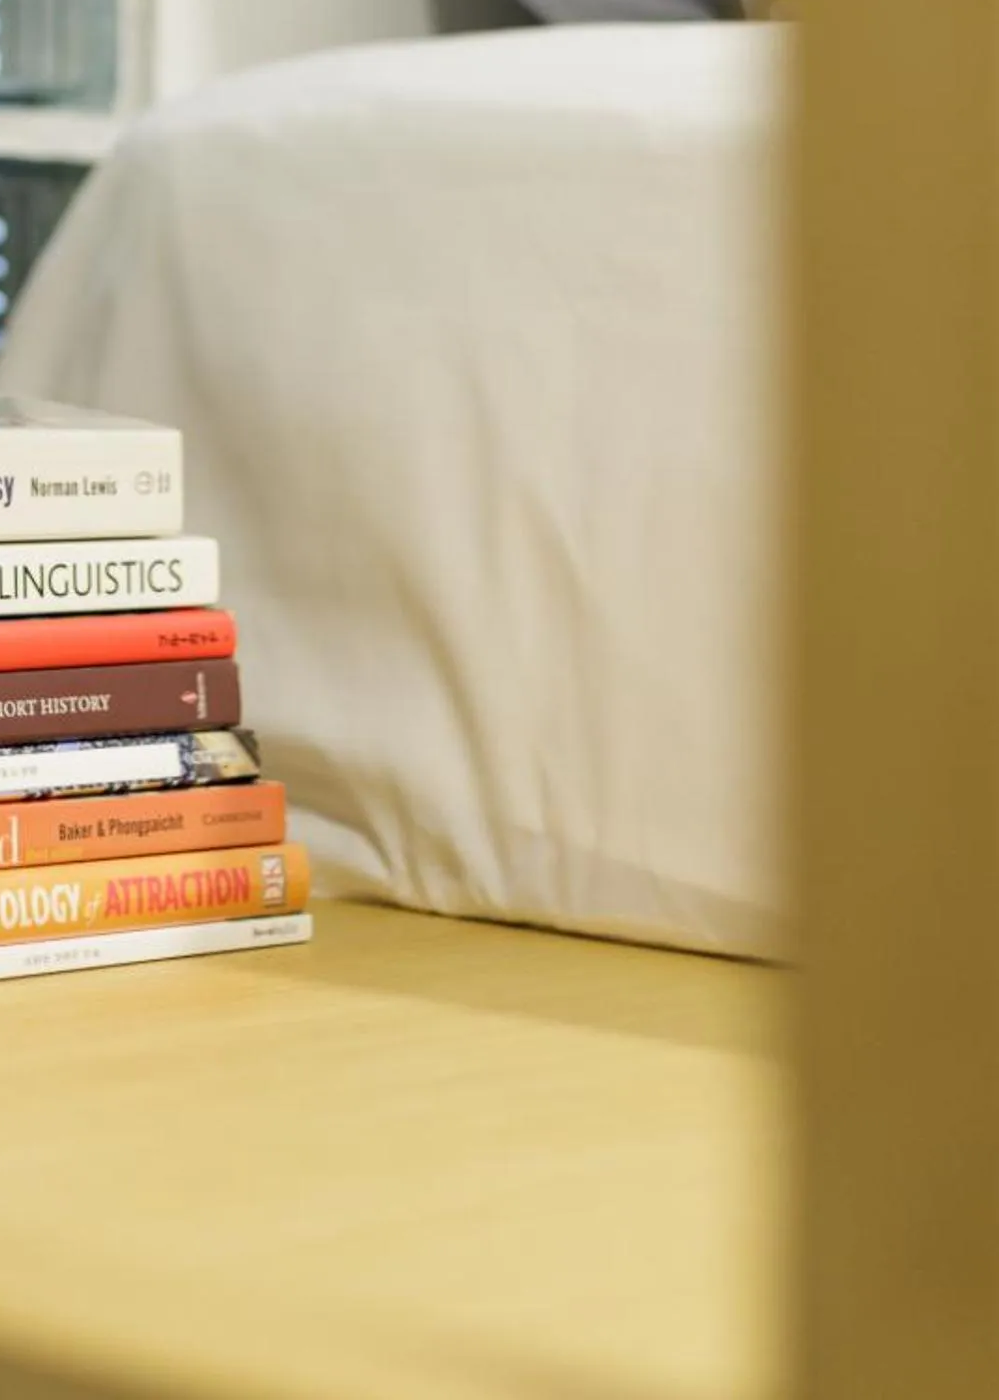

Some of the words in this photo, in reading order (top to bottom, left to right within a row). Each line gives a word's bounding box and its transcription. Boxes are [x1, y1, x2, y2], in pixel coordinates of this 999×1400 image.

[30, 476, 79, 498] Norman
[82, 474, 118, 496] Lewis
[40, 694, 112, 717] HISTORY
[58, 823, 93, 842] Baker
[97, 821, 105, 837] &
[108, 813, 184, 837] Phongpaichit
[104, 867, 250, 919] ATTRACTION
